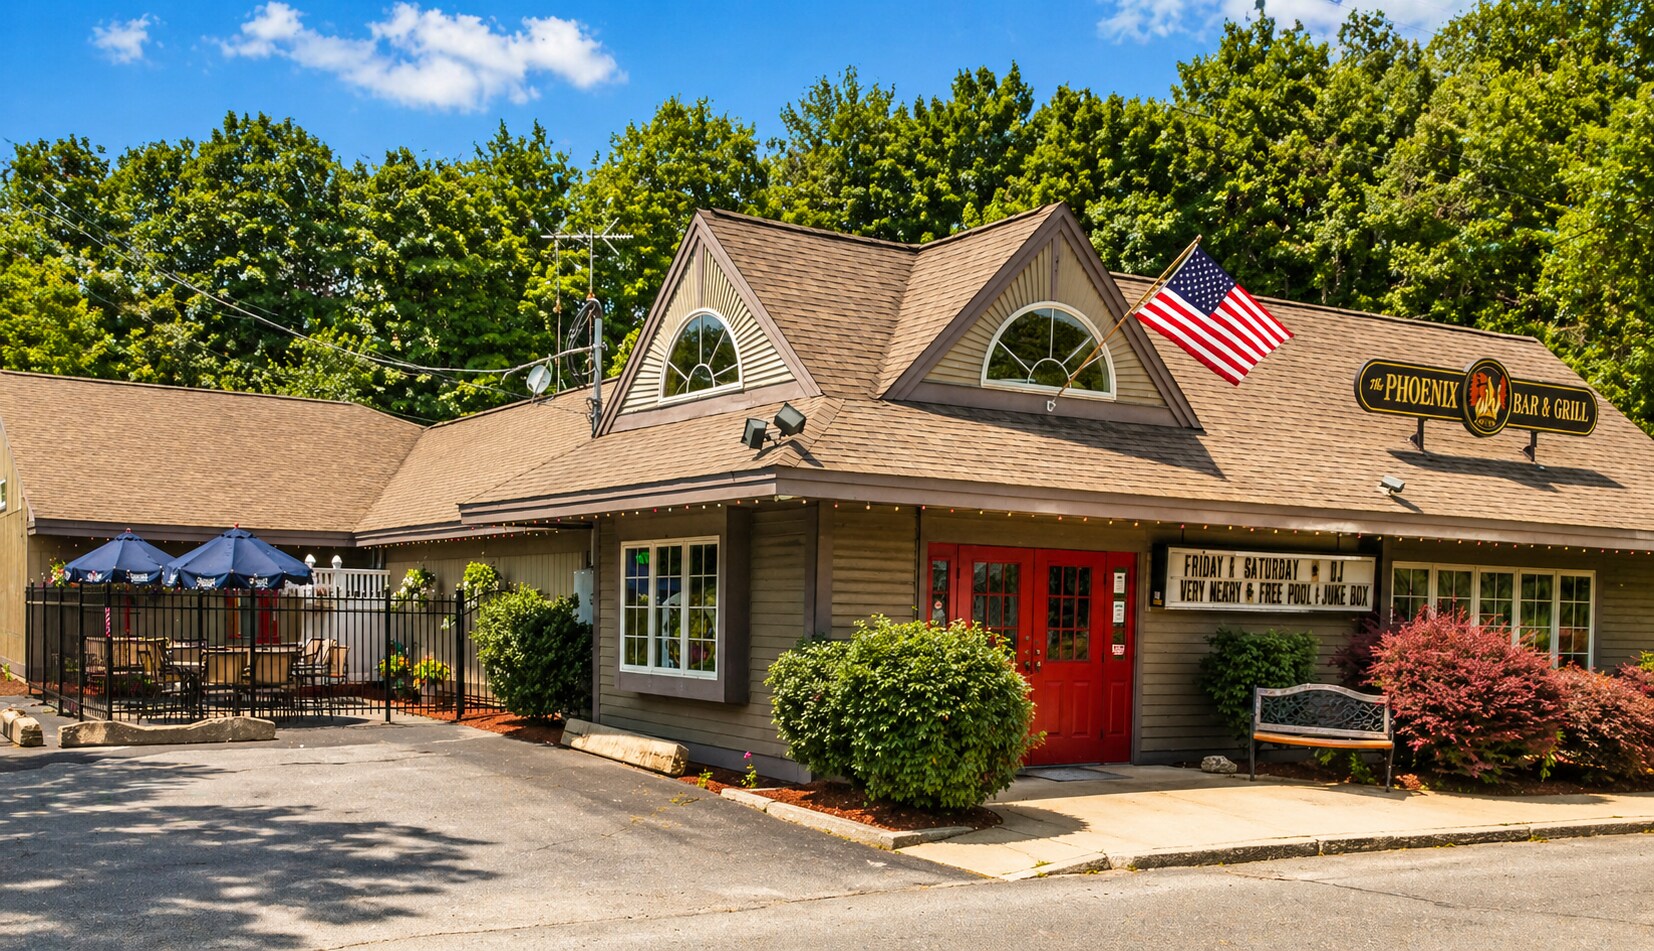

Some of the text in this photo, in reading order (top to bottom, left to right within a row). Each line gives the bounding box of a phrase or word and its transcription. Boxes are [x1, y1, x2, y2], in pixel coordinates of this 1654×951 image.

[1369, 373, 1589, 422] The PHOENIX BAR & GRILL
[1184, 555, 1223, 578] FRIDAY
[1244, 557, 1299, 580] SATURDAY
[1330, 561, 1344, 582] DJ
[1180, 579, 1205, 602] VERY
[1259, 582, 1283, 604] FREE
[1287, 583, 1311, 605] POOL
[1322, 584, 1346, 606] JUKE
[1350, 585, 1369, 606] BOX
